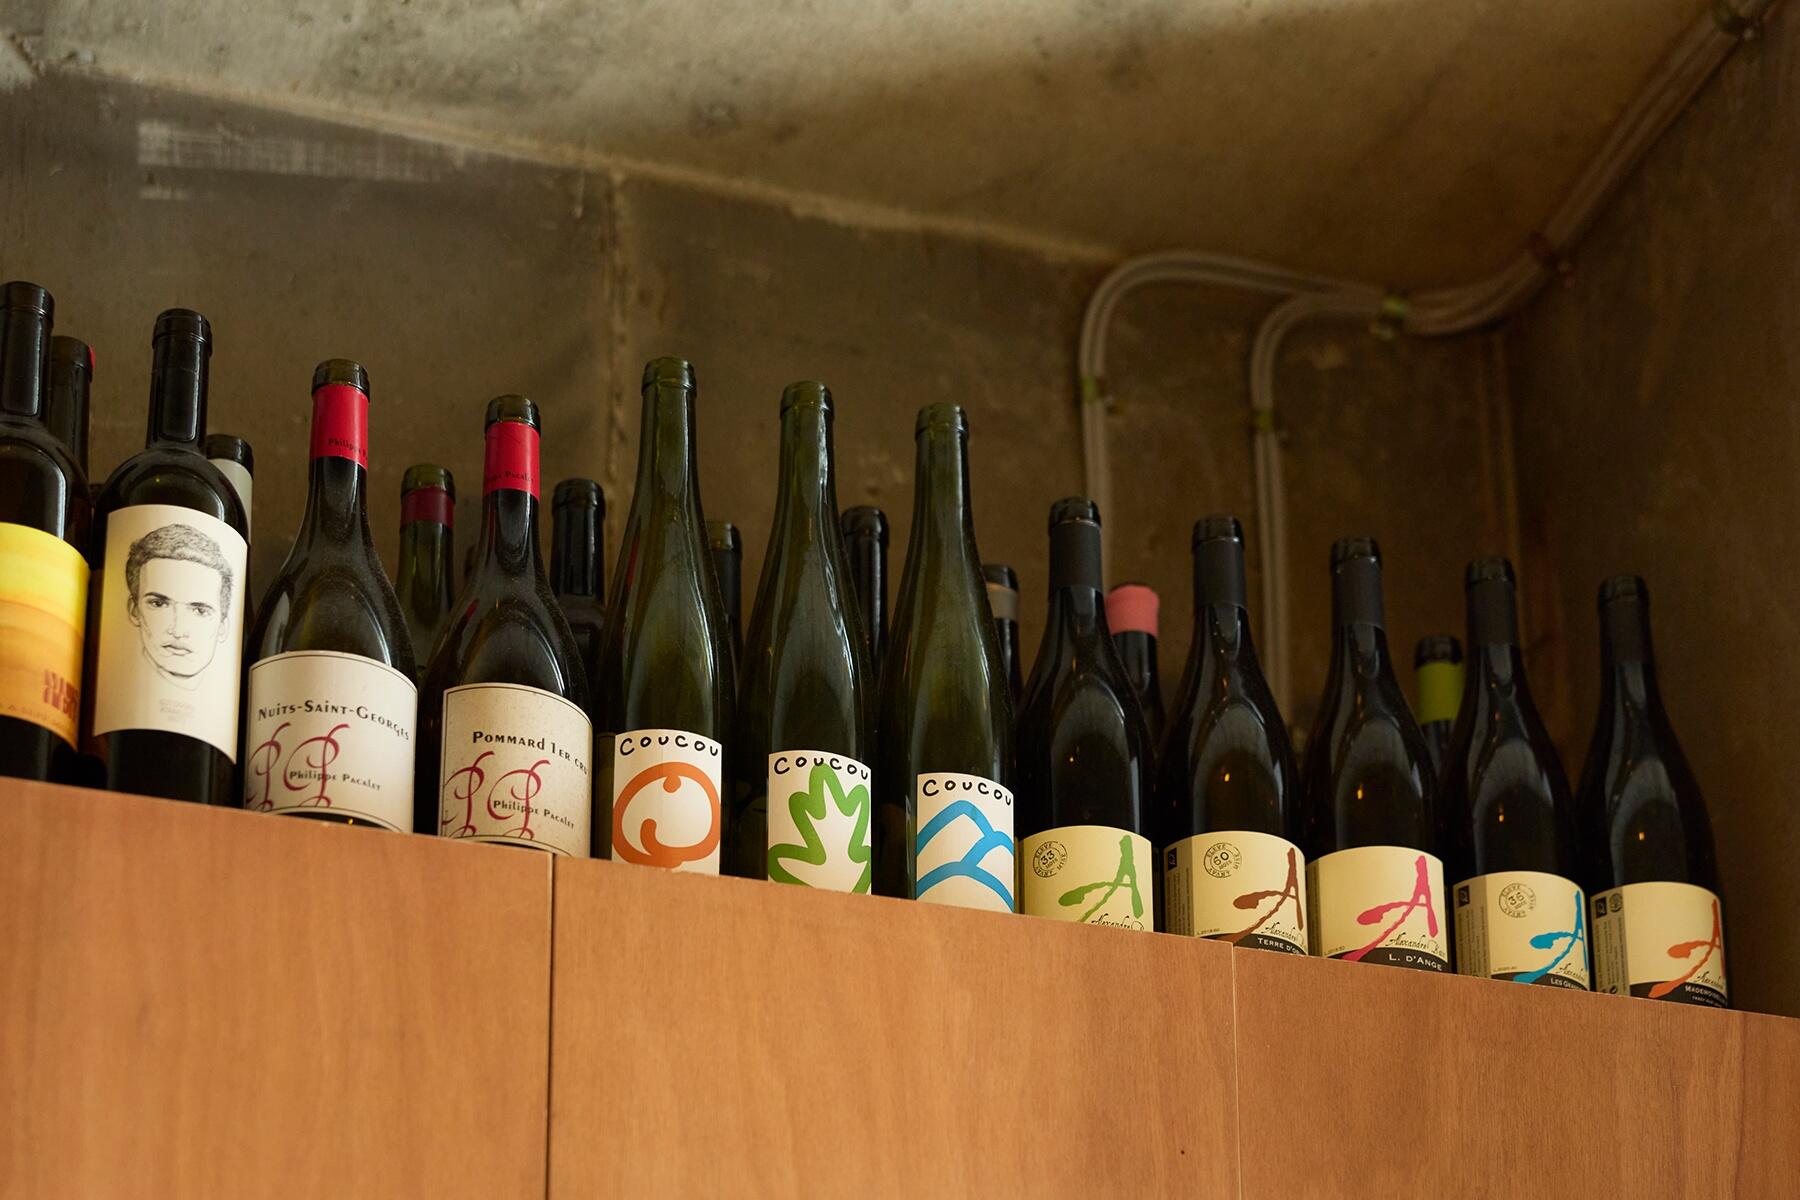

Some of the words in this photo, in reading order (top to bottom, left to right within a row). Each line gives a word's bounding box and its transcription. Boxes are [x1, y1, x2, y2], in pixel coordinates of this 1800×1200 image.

[1041, 850, 1055, 865] 33
[1213, 851, 1229, 866] 60
[1257, 937, 1284, 949] TERRE
[1389, 953, 1401, 961] L.
[1405, 955, 1442, 971] D'ANGE
